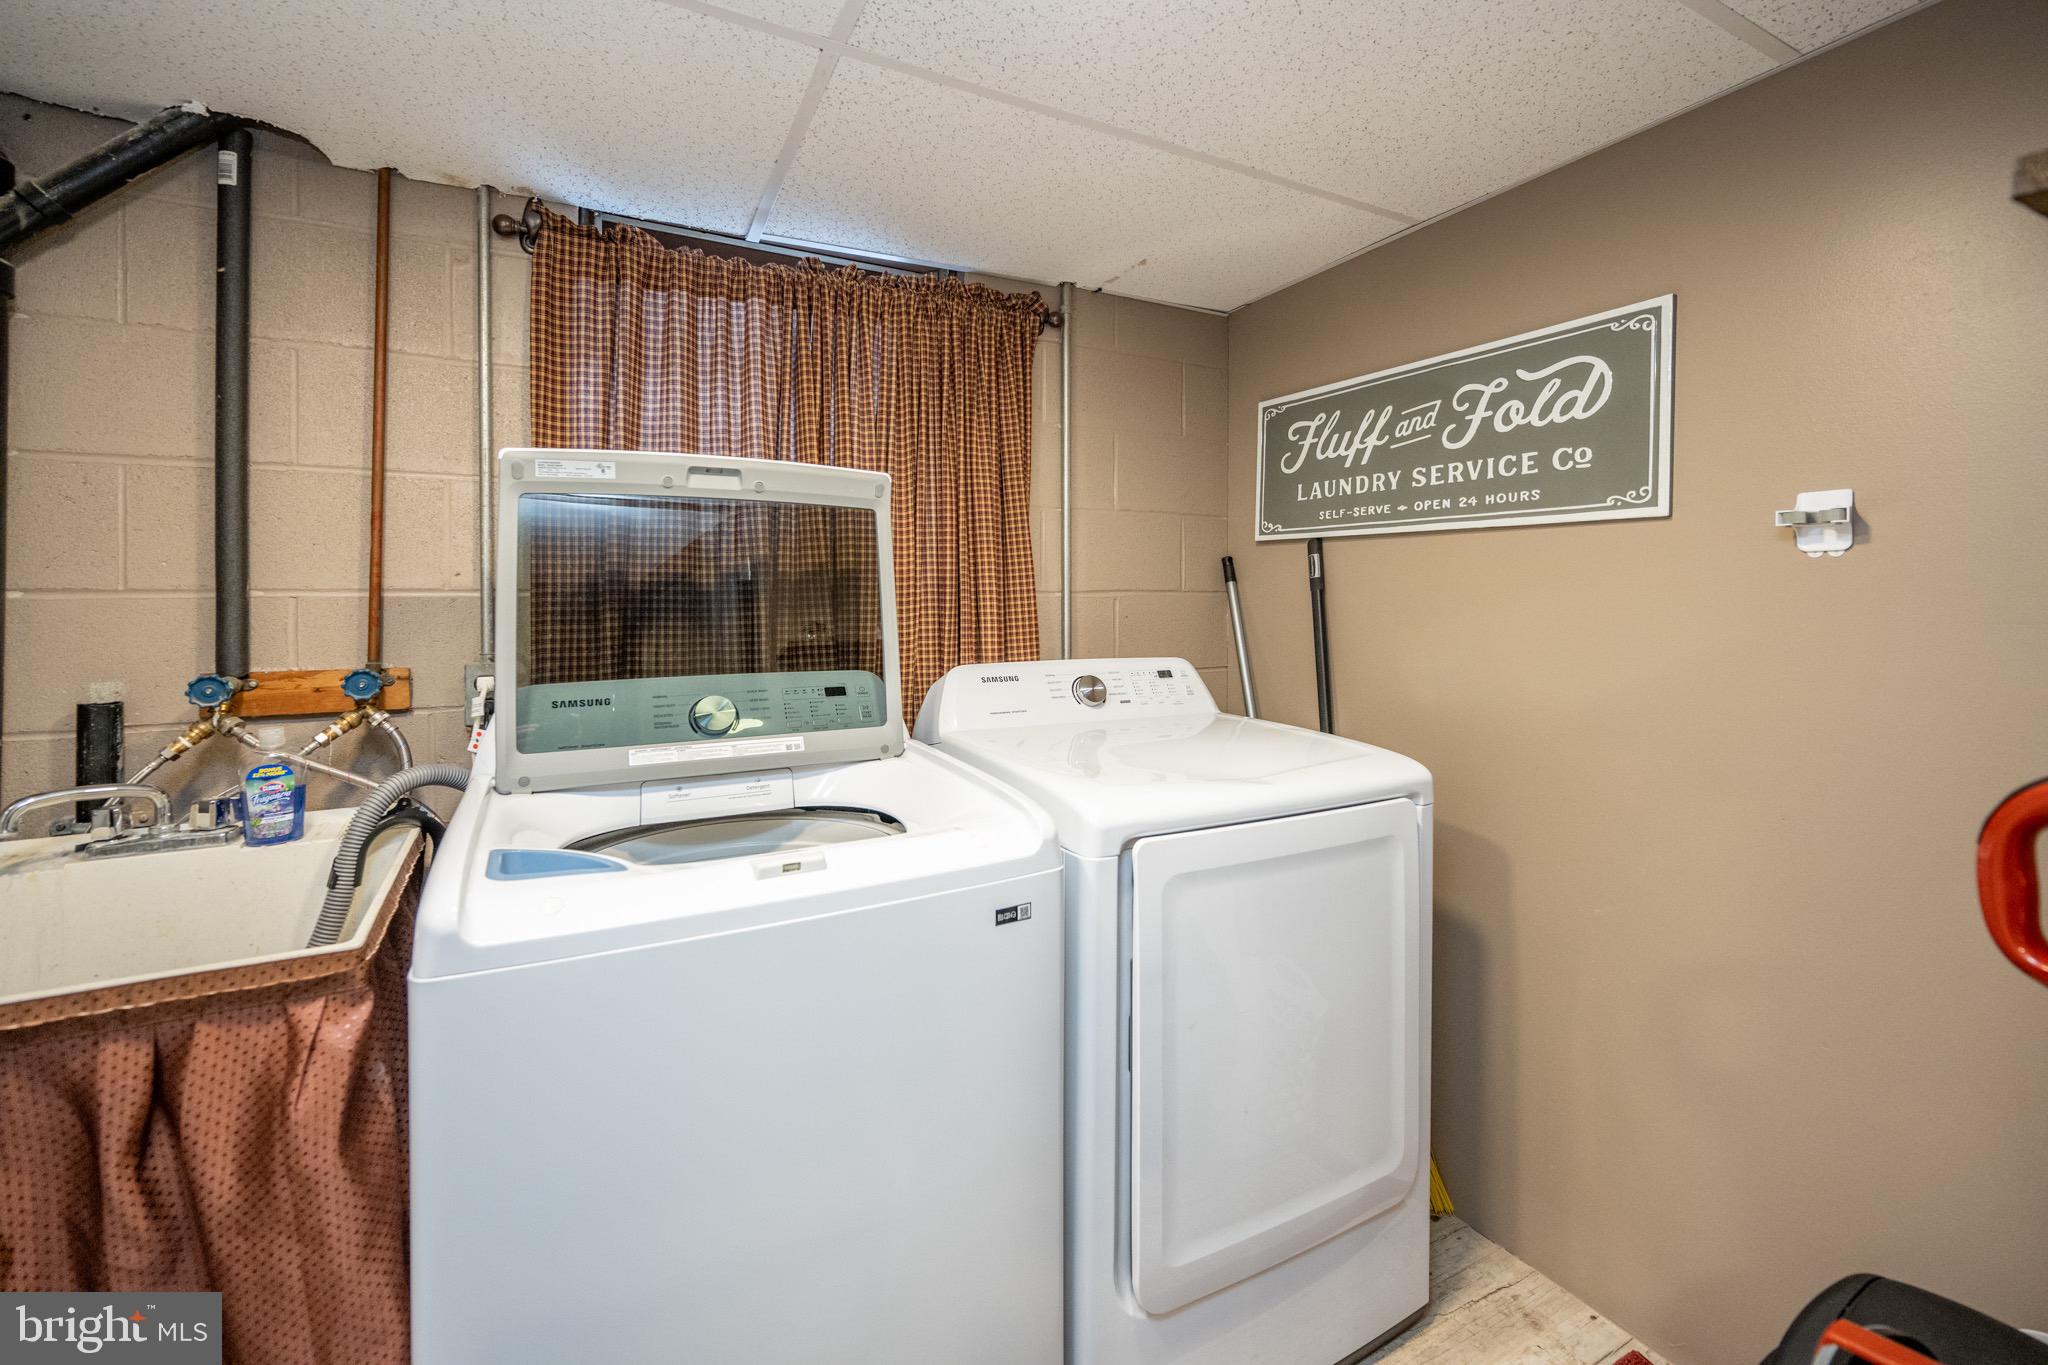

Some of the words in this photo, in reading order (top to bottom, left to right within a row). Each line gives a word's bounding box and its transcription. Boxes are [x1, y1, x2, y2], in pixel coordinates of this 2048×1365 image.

[1281, 405, 1393, 474] Fluff
[1394, 400, 1442, 440] and
[1442, 355, 1613, 450] Fold
[1297, 470, 1402, 502] LAUNDRY
[1411, 451, 1539, 488] SERVICE
[1318, 504, 1392, 520] SELF-SERVE
[1414, 497, 1451, 512] OPEN
[1458, 495, 1478, 508] 24
[1485, 489, 1541, 505] HOURS
[981, 675, 1020, 684] SAMSUNG
[551, 697, 612, 709] SAMSUNG
